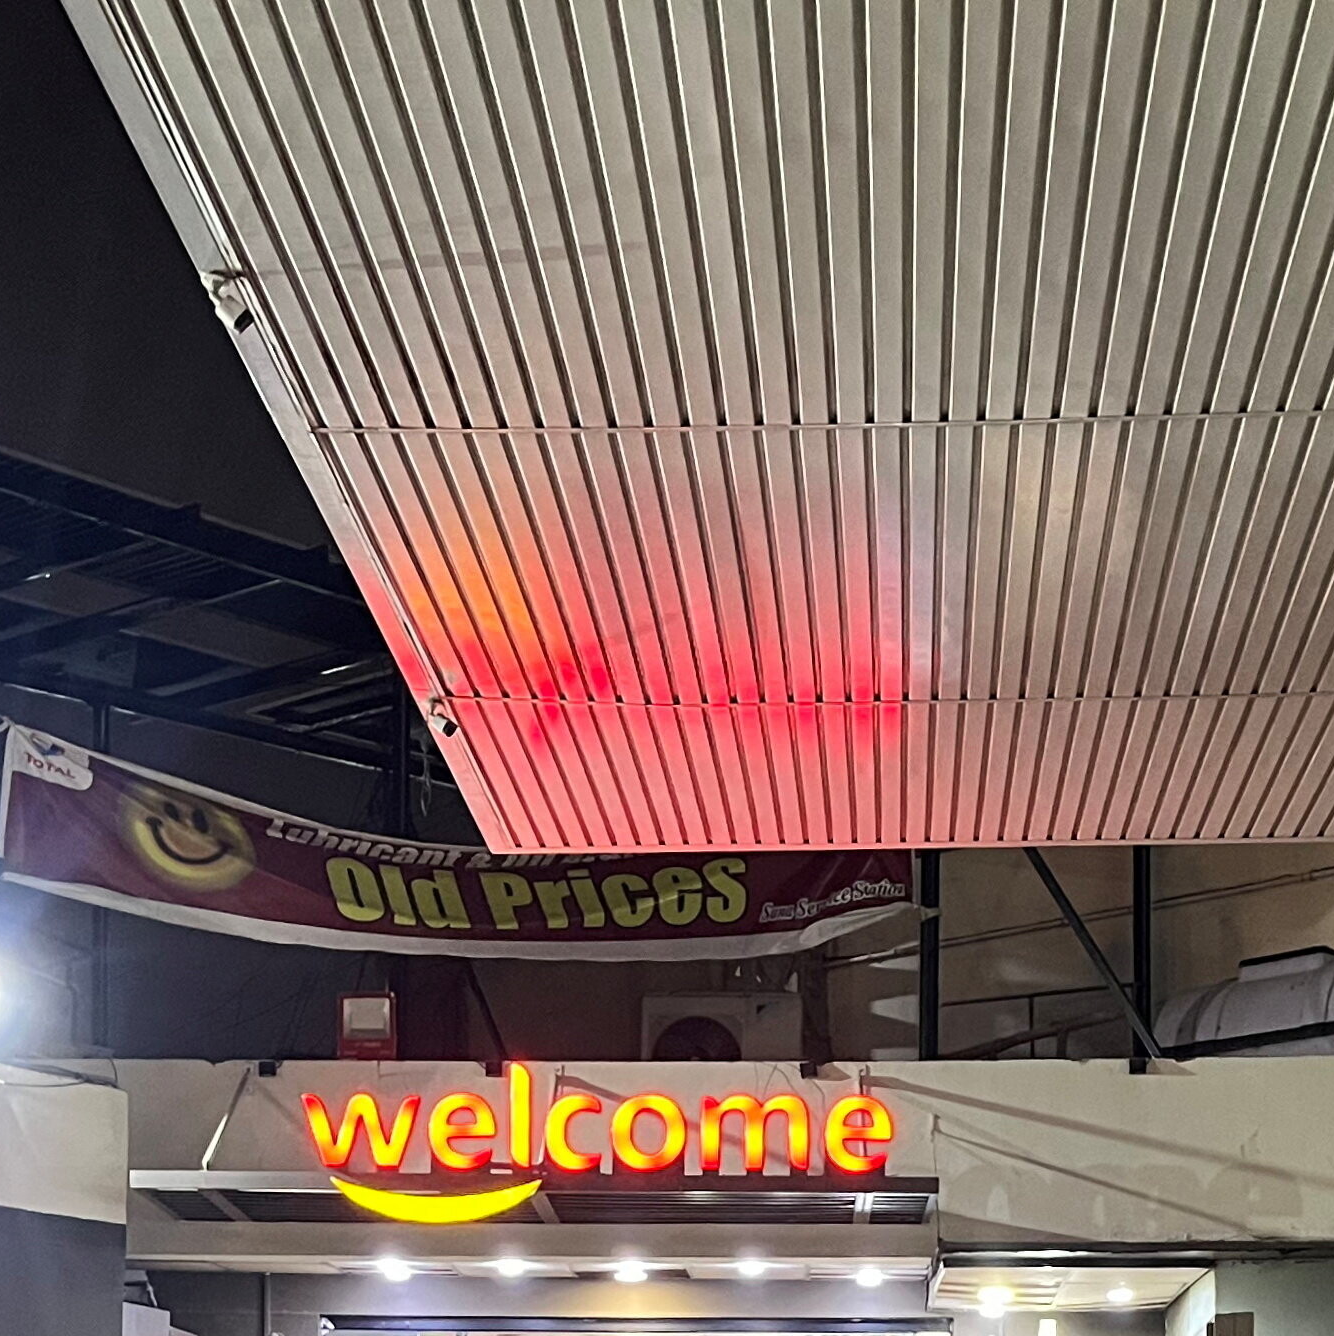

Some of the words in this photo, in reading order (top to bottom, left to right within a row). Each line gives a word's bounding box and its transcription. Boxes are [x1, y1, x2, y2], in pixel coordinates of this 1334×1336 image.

[24, 752, 76, 780] TOTAL
[326, 856, 470, 930] Old
[301, 1062, 894, 1174] welcome
